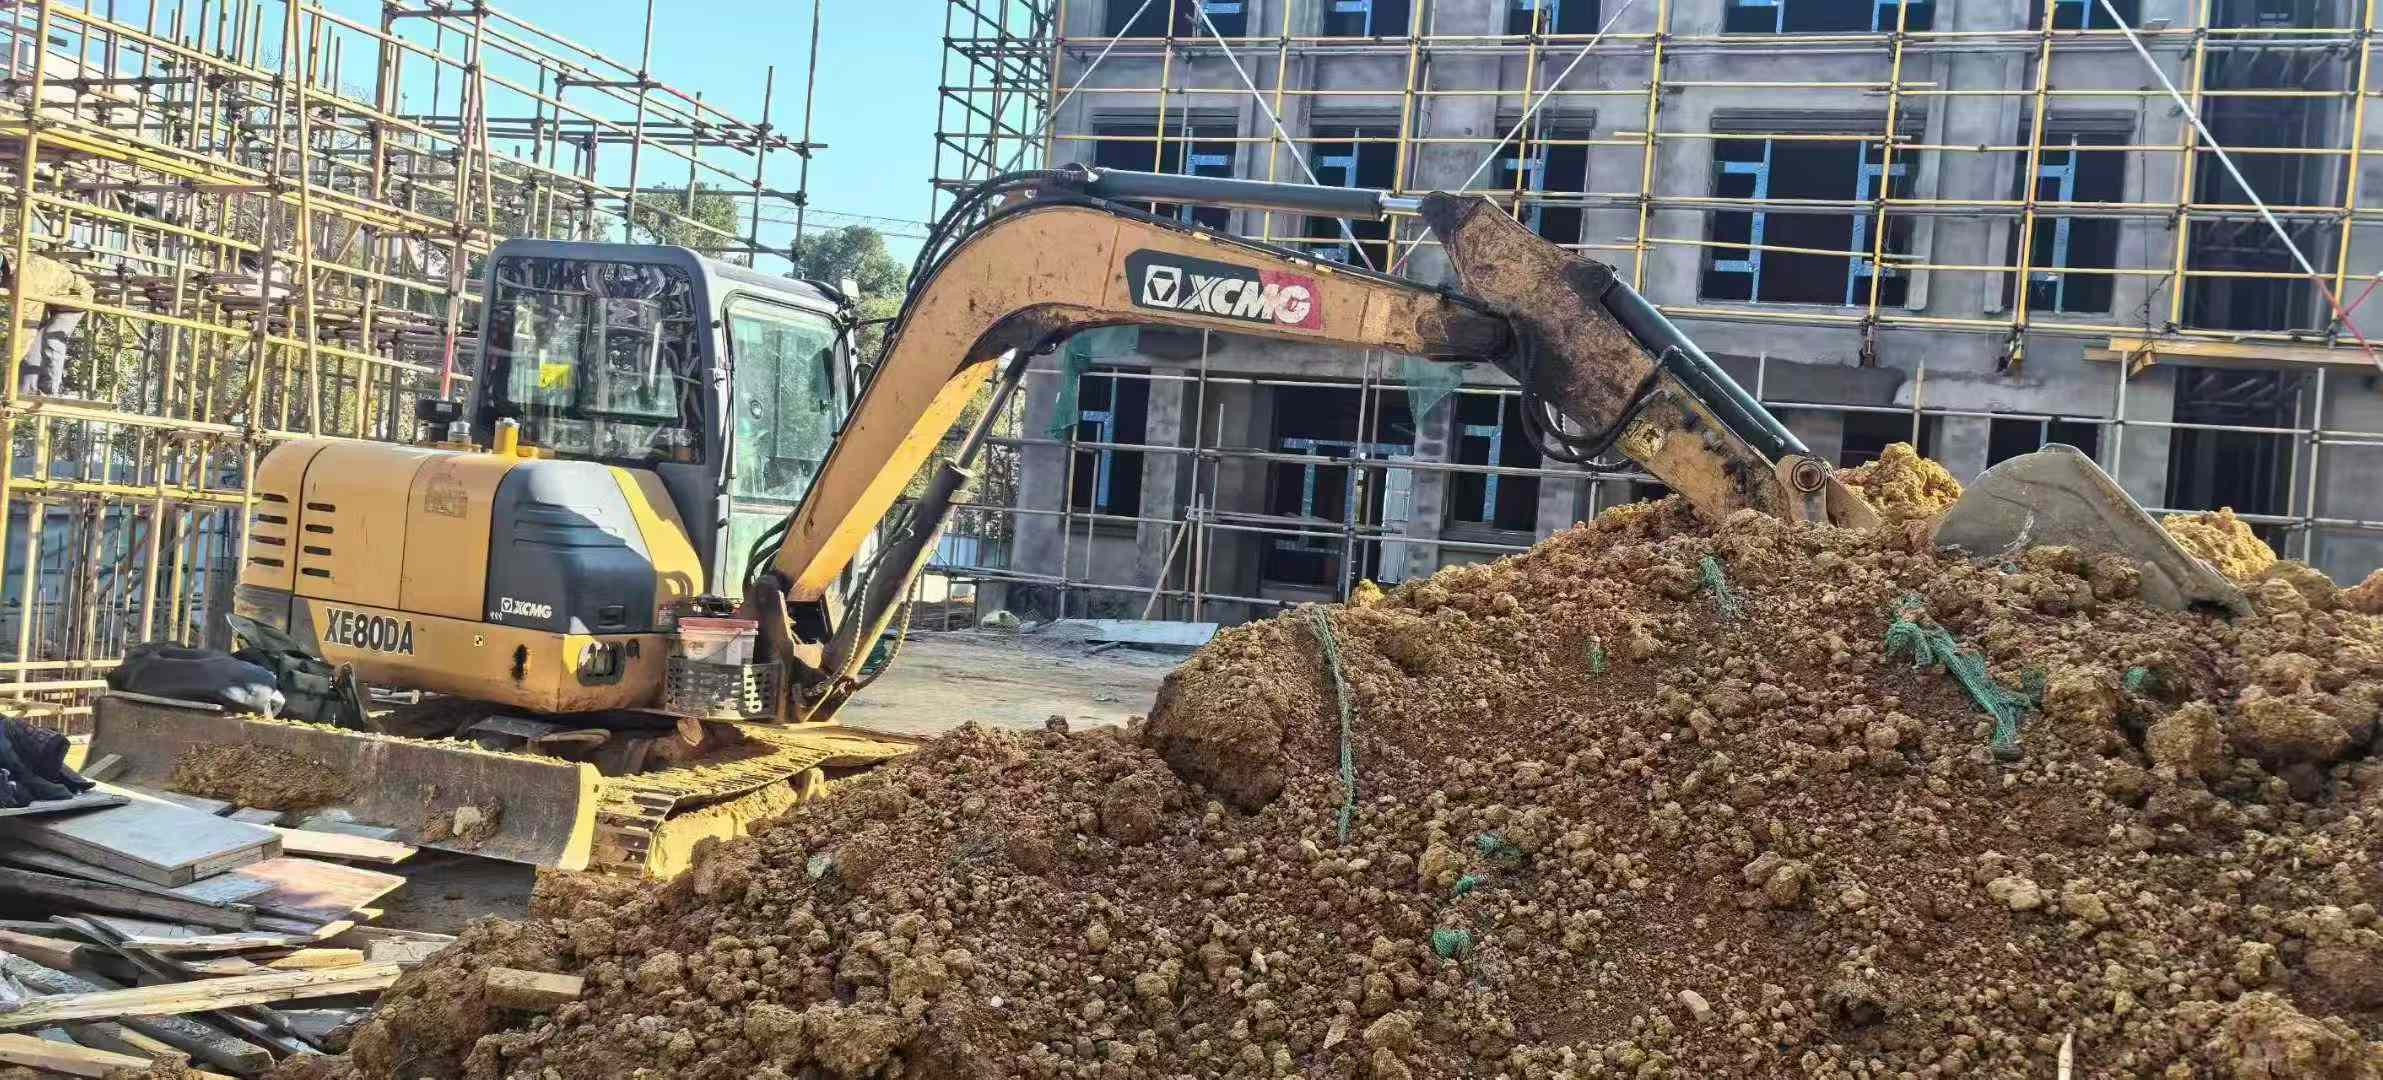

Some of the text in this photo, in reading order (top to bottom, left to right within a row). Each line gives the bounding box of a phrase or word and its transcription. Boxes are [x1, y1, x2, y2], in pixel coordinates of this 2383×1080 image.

[1178, 273, 1311, 324] XCMG
[323, 607, 415, 656] XE80DA
[513, 600, 552, 619] XCMG
